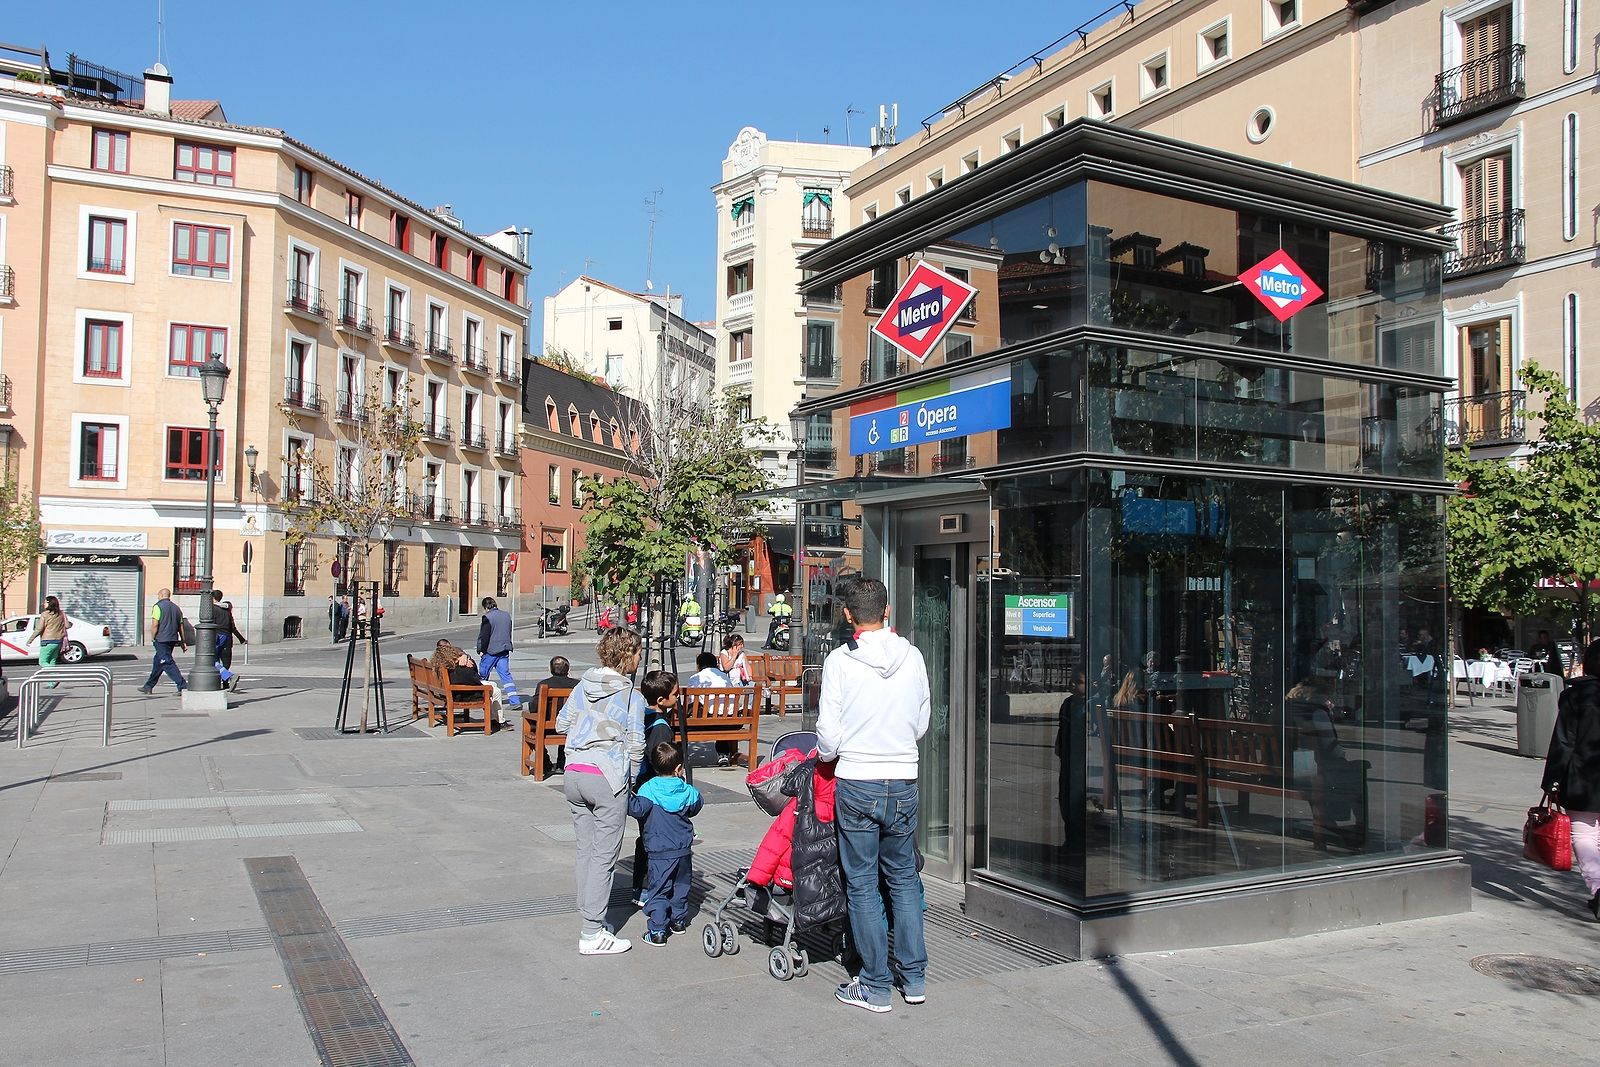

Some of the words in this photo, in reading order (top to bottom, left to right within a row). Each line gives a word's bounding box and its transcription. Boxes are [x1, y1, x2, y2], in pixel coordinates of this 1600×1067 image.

[1262, 275, 1300, 296] Metro
[900, 300, 940, 328] Metro
[917, 402, 957, 430] Ópera
[53, 533, 142, 545] Baronet
[89, 554, 120, 564] Baronet
[1017, 595, 1057, 608] Ascensor
